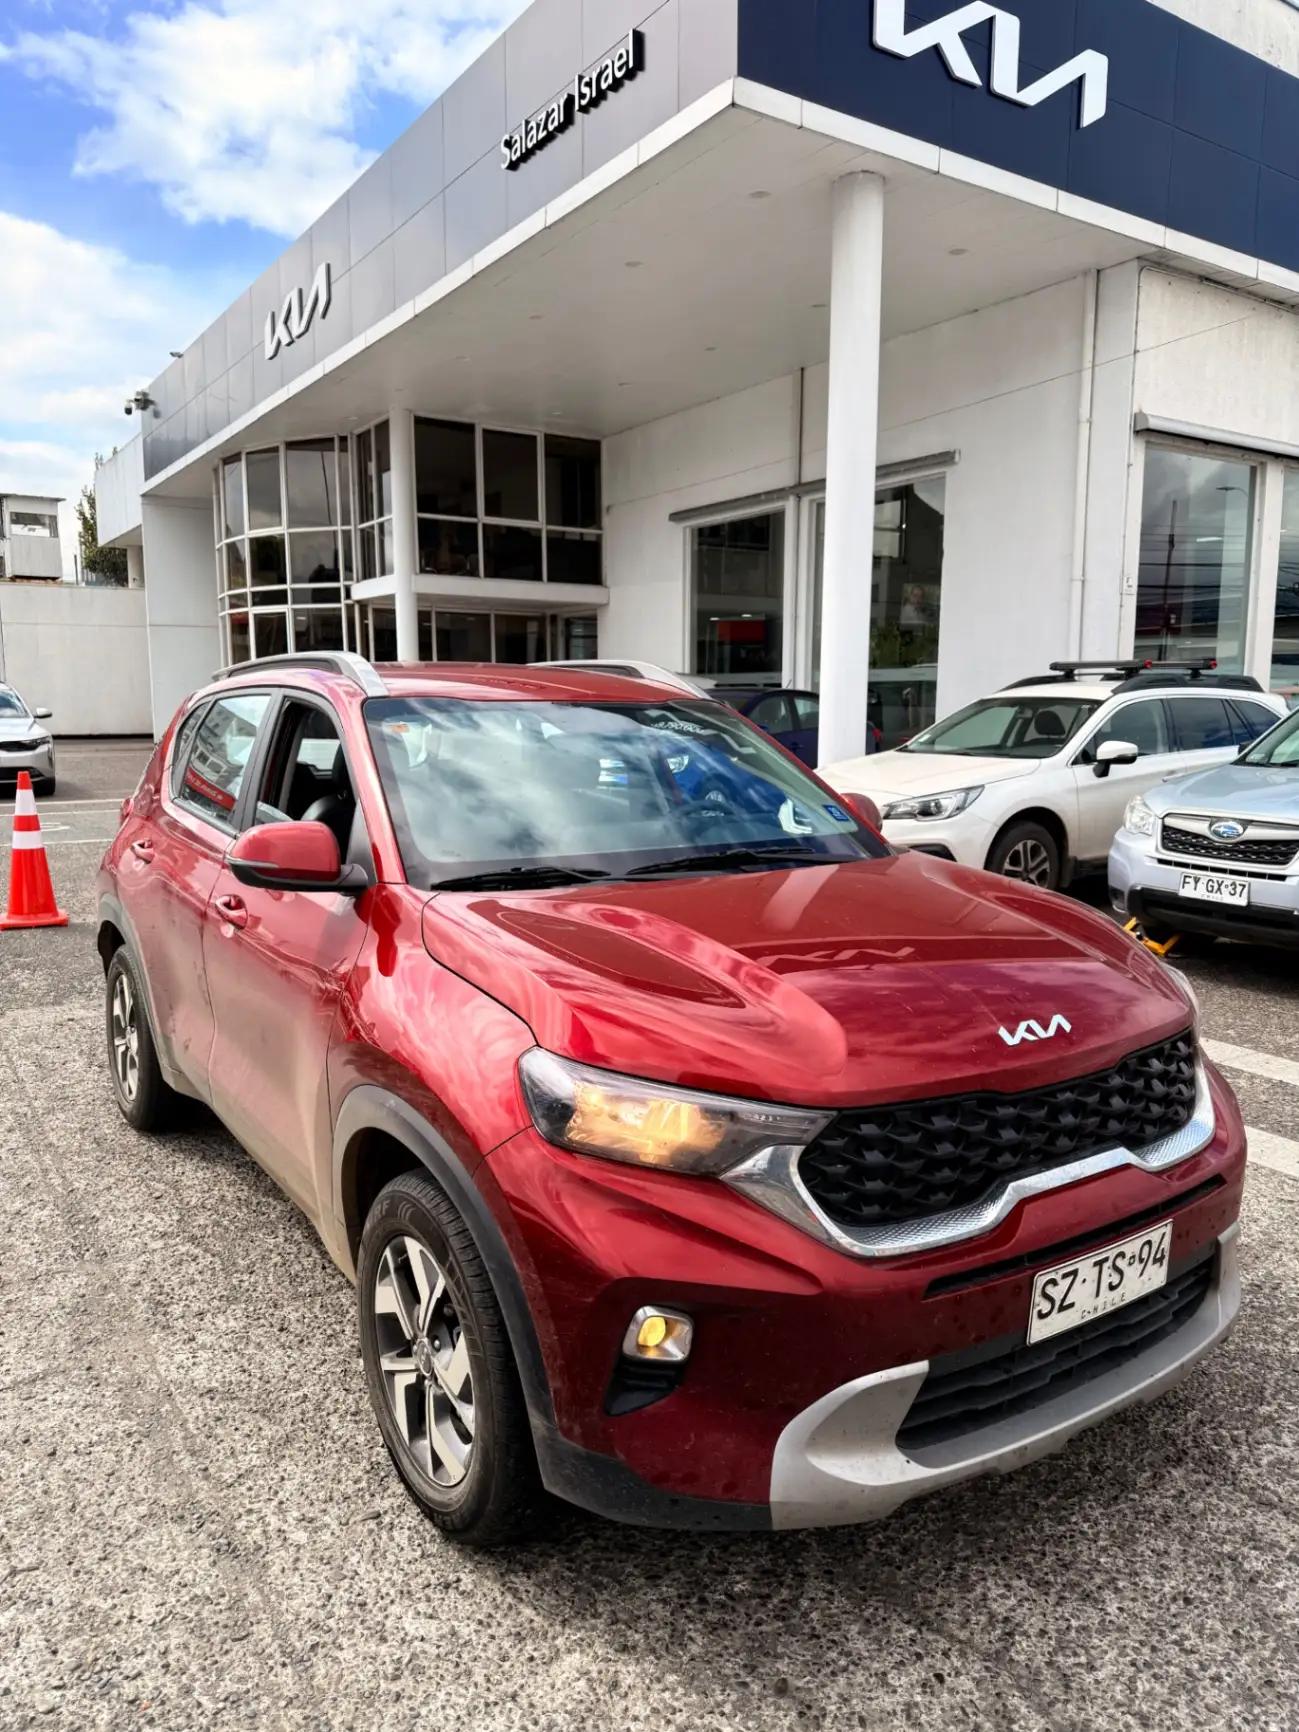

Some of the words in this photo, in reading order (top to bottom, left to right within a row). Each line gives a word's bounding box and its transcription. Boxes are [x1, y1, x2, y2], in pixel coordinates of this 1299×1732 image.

[500, 92, 571, 170] Salazar
[574, 28, 640, 114] Israel
[872, 0, 1109, 128] KIA
[263, 262, 330, 360] KIA
[998, 1013, 1072, 1046] KIA
